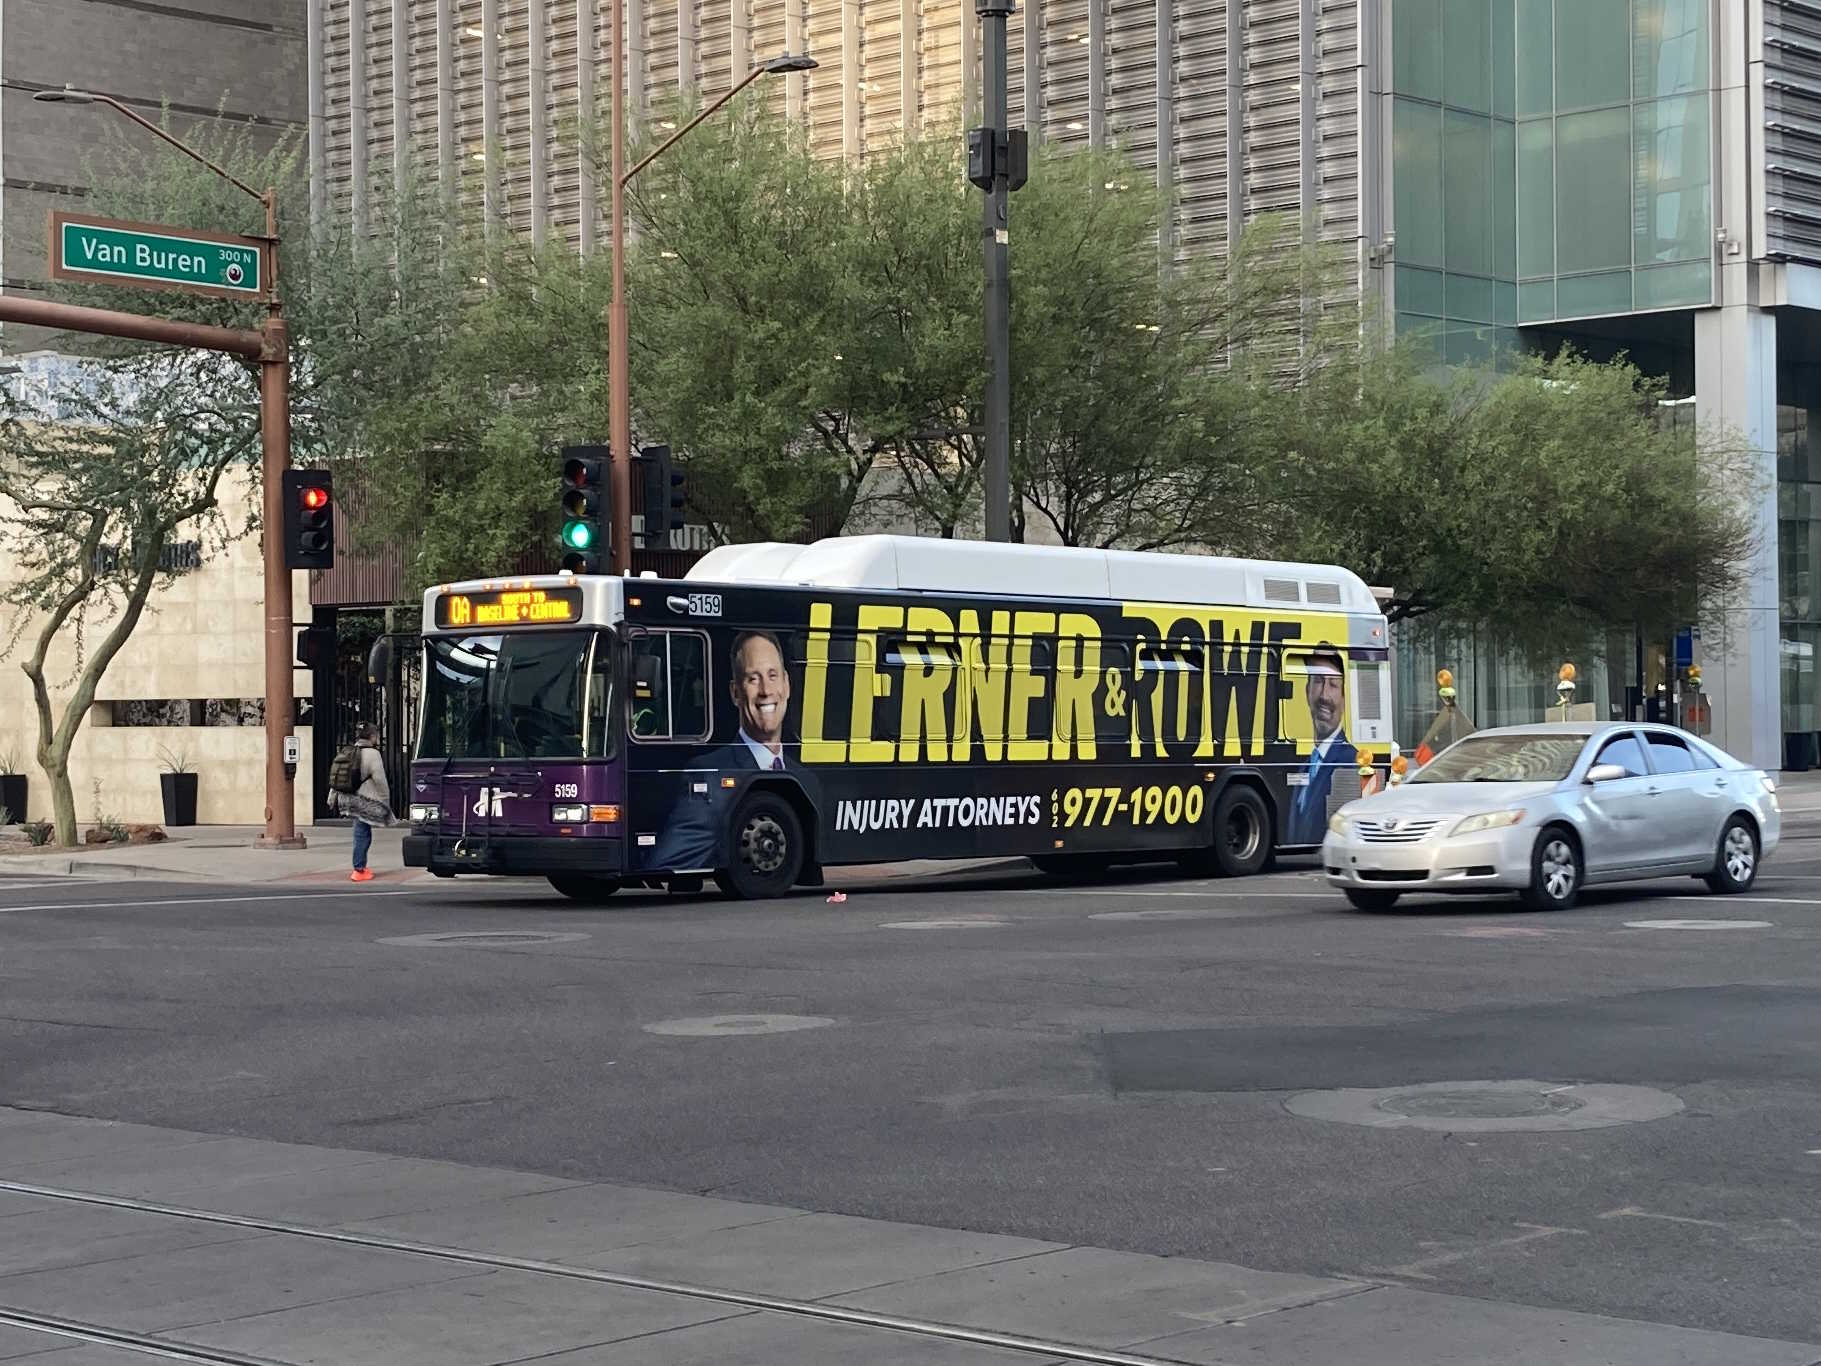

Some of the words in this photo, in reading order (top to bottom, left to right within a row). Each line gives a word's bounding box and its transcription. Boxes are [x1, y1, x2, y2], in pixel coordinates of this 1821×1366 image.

[82, 237, 127, 264] Van
[135, 243, 206, 274] Buren
[218, 249, 241, 263] 300
[243, 253, 251, 264] N
[689, 595, 721, 614] 5159
[800, 602, 1102, 763] LERNER
[1104, 667, 1127, 717] &
[1119, 615, 1302, 758] ROWE
[554, 783, 578, 798] 5159
[1063, 784, 1204, 828] 977-1900
[835, 799, 915, 834] INJURY
[916, 795, 1041, 830] ATTORNEYS
